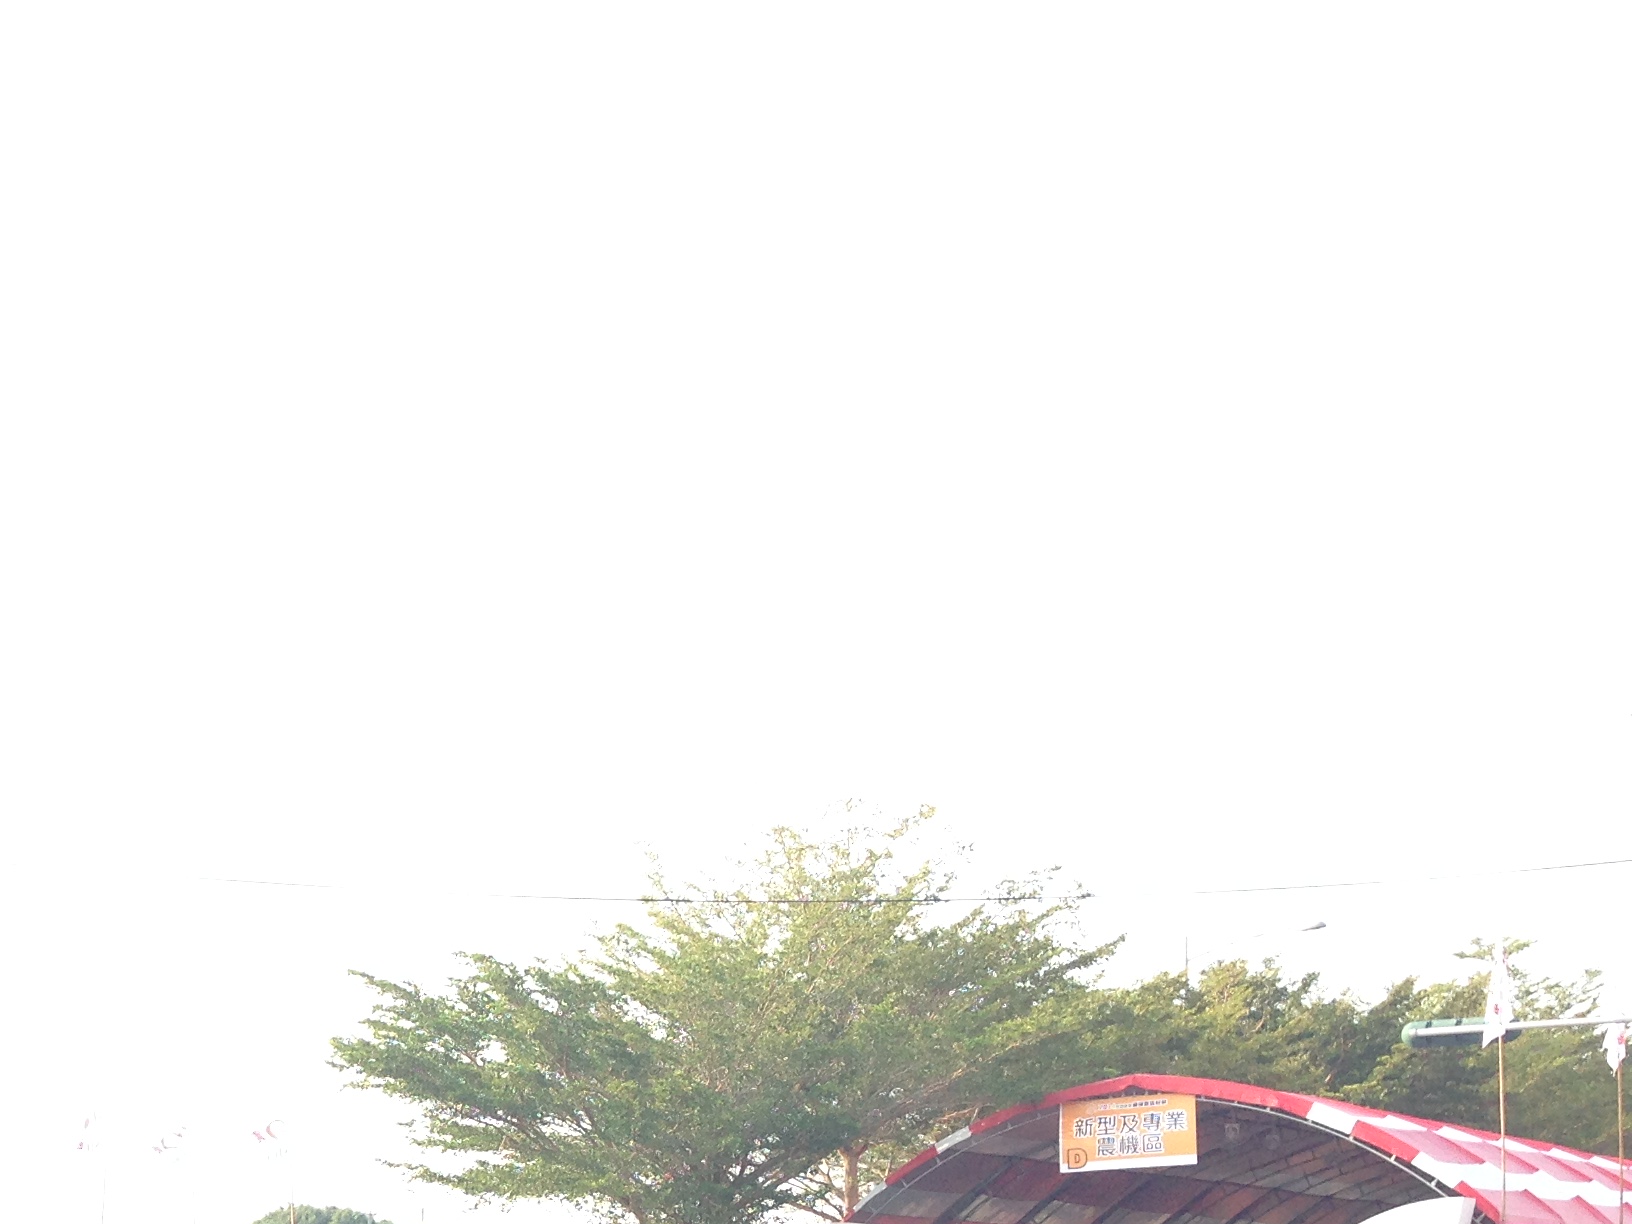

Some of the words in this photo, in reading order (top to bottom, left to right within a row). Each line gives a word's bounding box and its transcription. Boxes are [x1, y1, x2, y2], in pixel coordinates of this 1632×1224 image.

[1074, 1111, 1185, 1138] 新型及專業
[1097, 1134, 1164, 1156] 農機區
